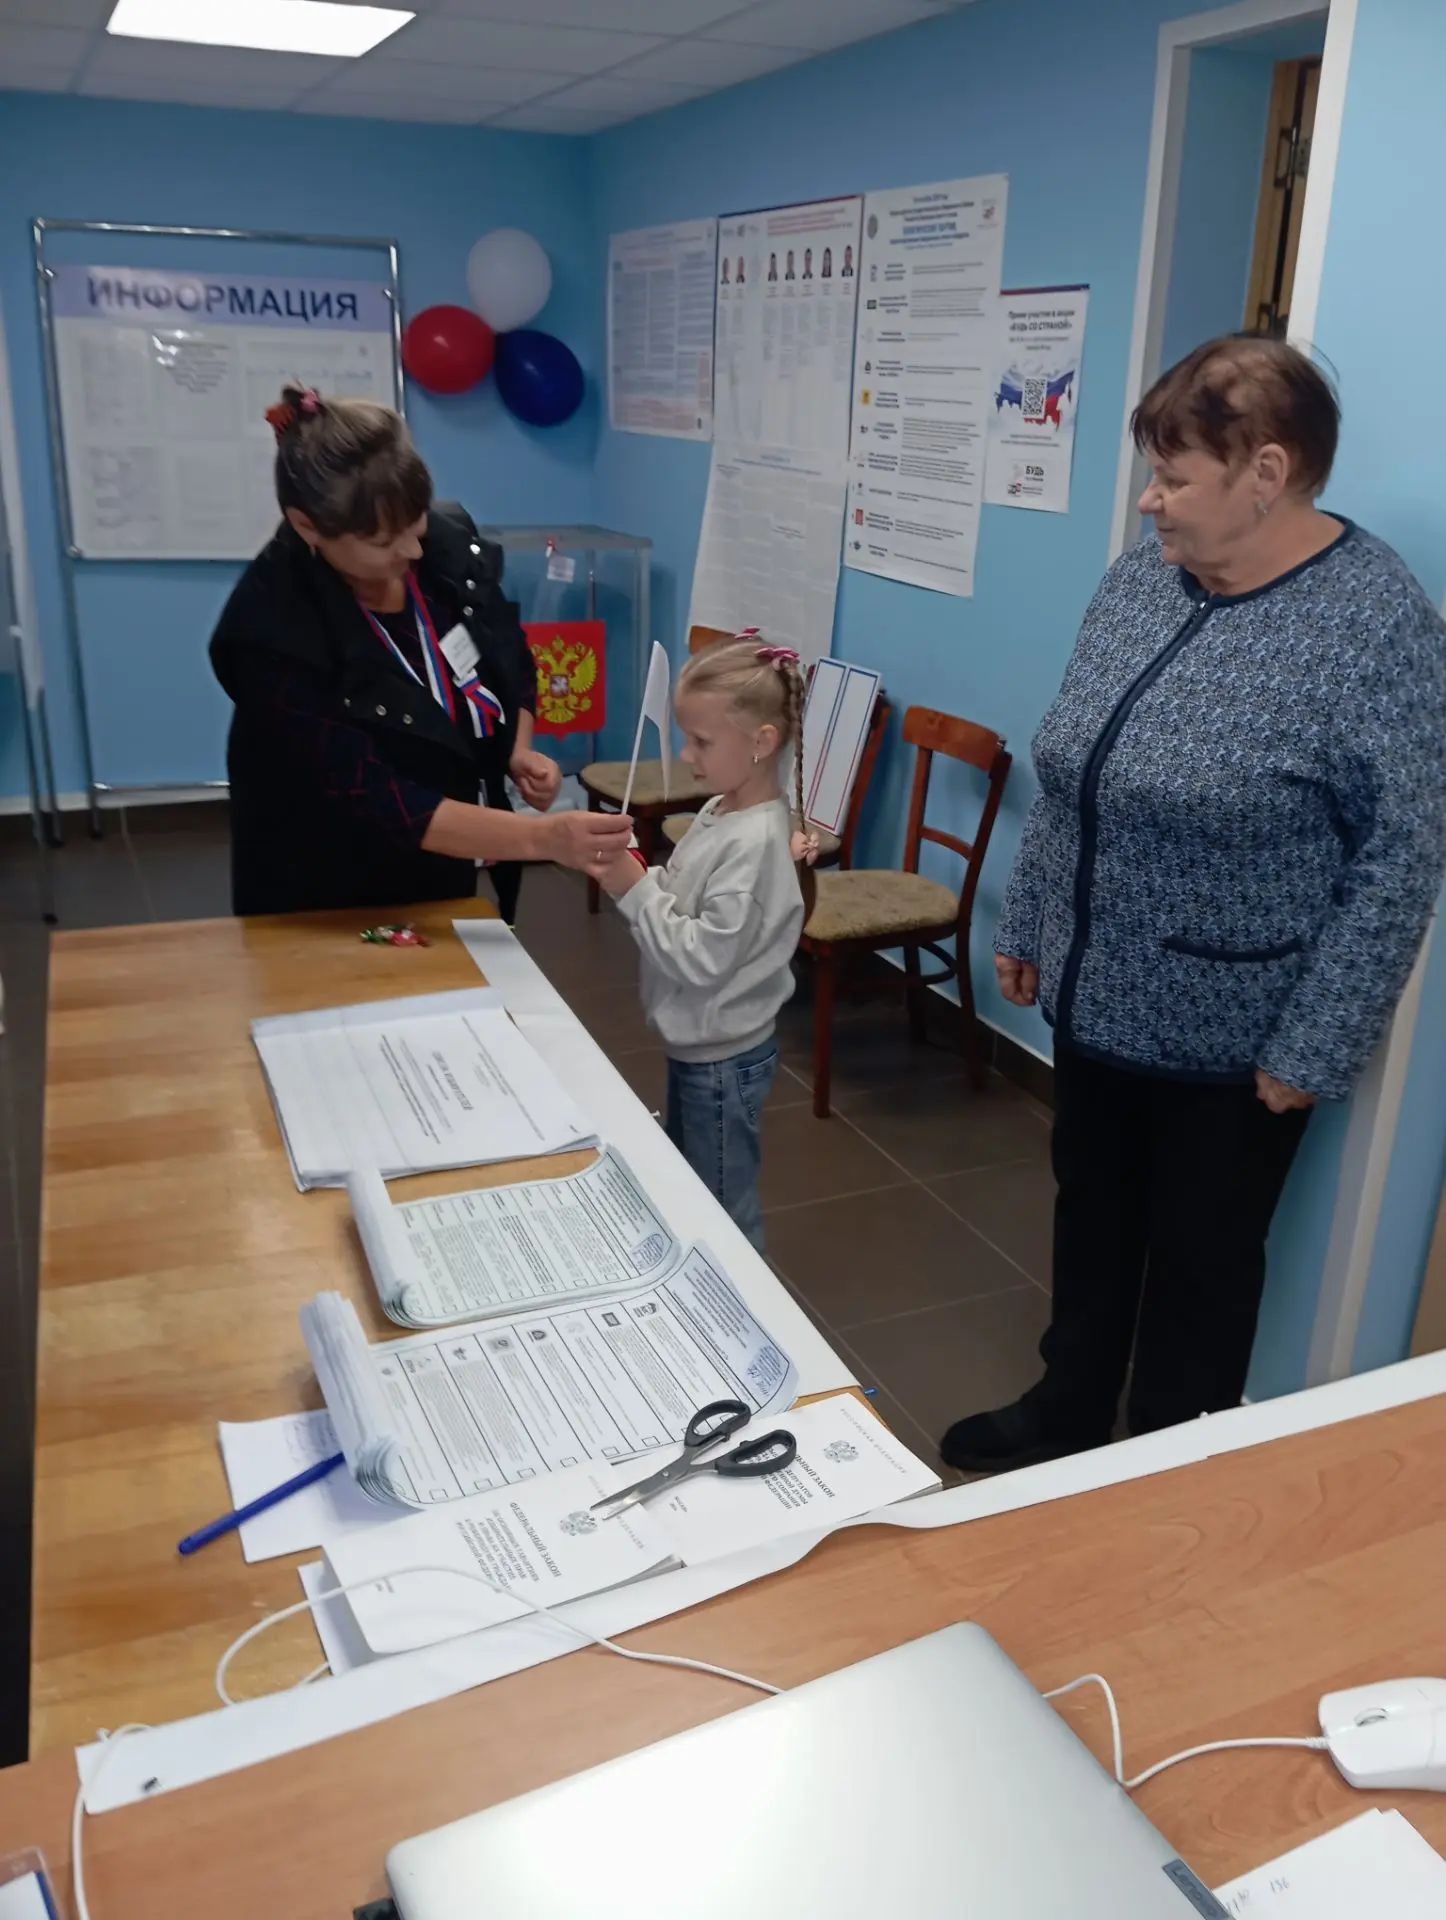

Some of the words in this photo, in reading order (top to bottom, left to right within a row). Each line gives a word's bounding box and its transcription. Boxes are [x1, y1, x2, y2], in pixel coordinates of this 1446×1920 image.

[87, 277, 359, 322] ИНФОРМАЦИЯ
[812, 1476, 835, 1498] ЗАКОН
[509, 1502, 547, 1552] ФЕДЕРАЛЬНЫЙ
[541, 1551, 562, 1577] ЗАКОН
